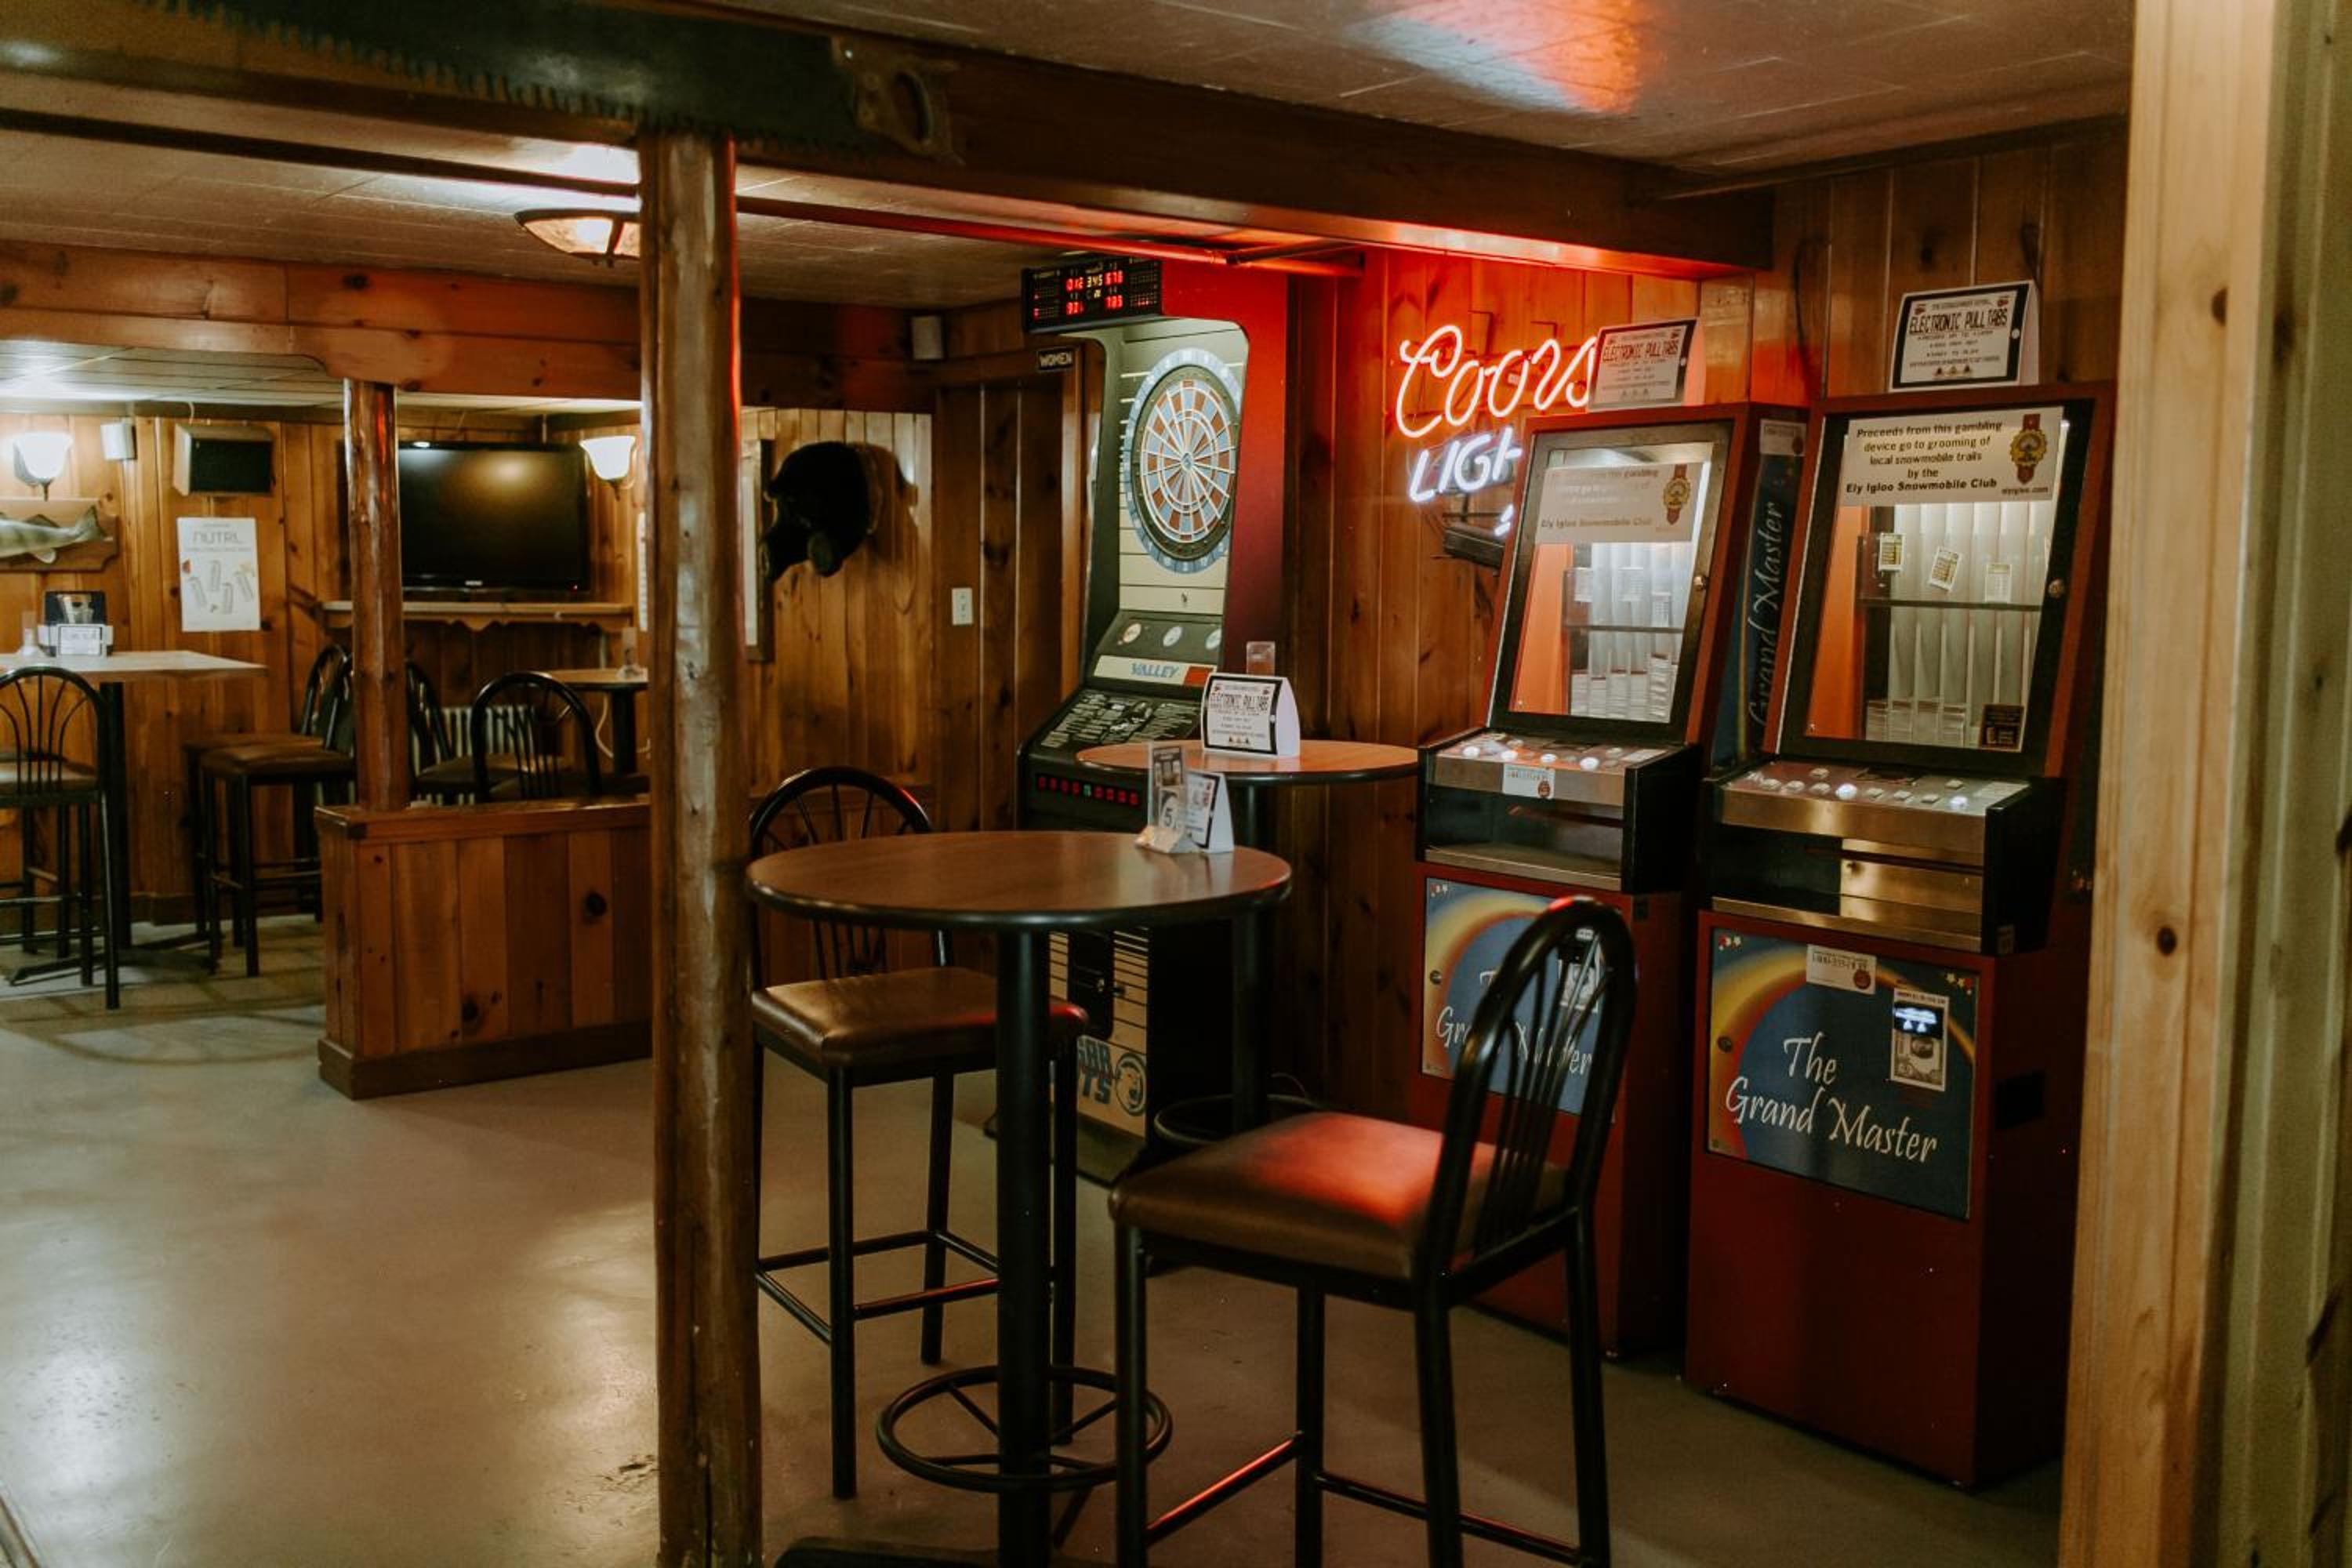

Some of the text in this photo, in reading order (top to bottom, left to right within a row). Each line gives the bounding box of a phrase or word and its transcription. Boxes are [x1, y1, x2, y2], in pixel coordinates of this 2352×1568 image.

[1909, 309, 2009, 335] ELECTRONIC PULL TABS
[1039, 352, 1073, 367] WOMEN
[1396, 325, 1598, 438] Coors
[1857, 421, 2003, 438] Proceeds from this gambling
[1864, 436, 1991, 452] device go to grooming of
[1870, 451, 1983, 466] local snowmobile trails
[1907, 467, 1939, 480] by the
[1846, 477, 1998, 495] Ely Igloo Snowmobile Club
[1753, 502, 1783, 612] Master
[1131, 662, 1180, 679] VALLEY
[1784, 1031, 1837, 1085] The
[1726, 1076, 1938, 1163] Grand Master
